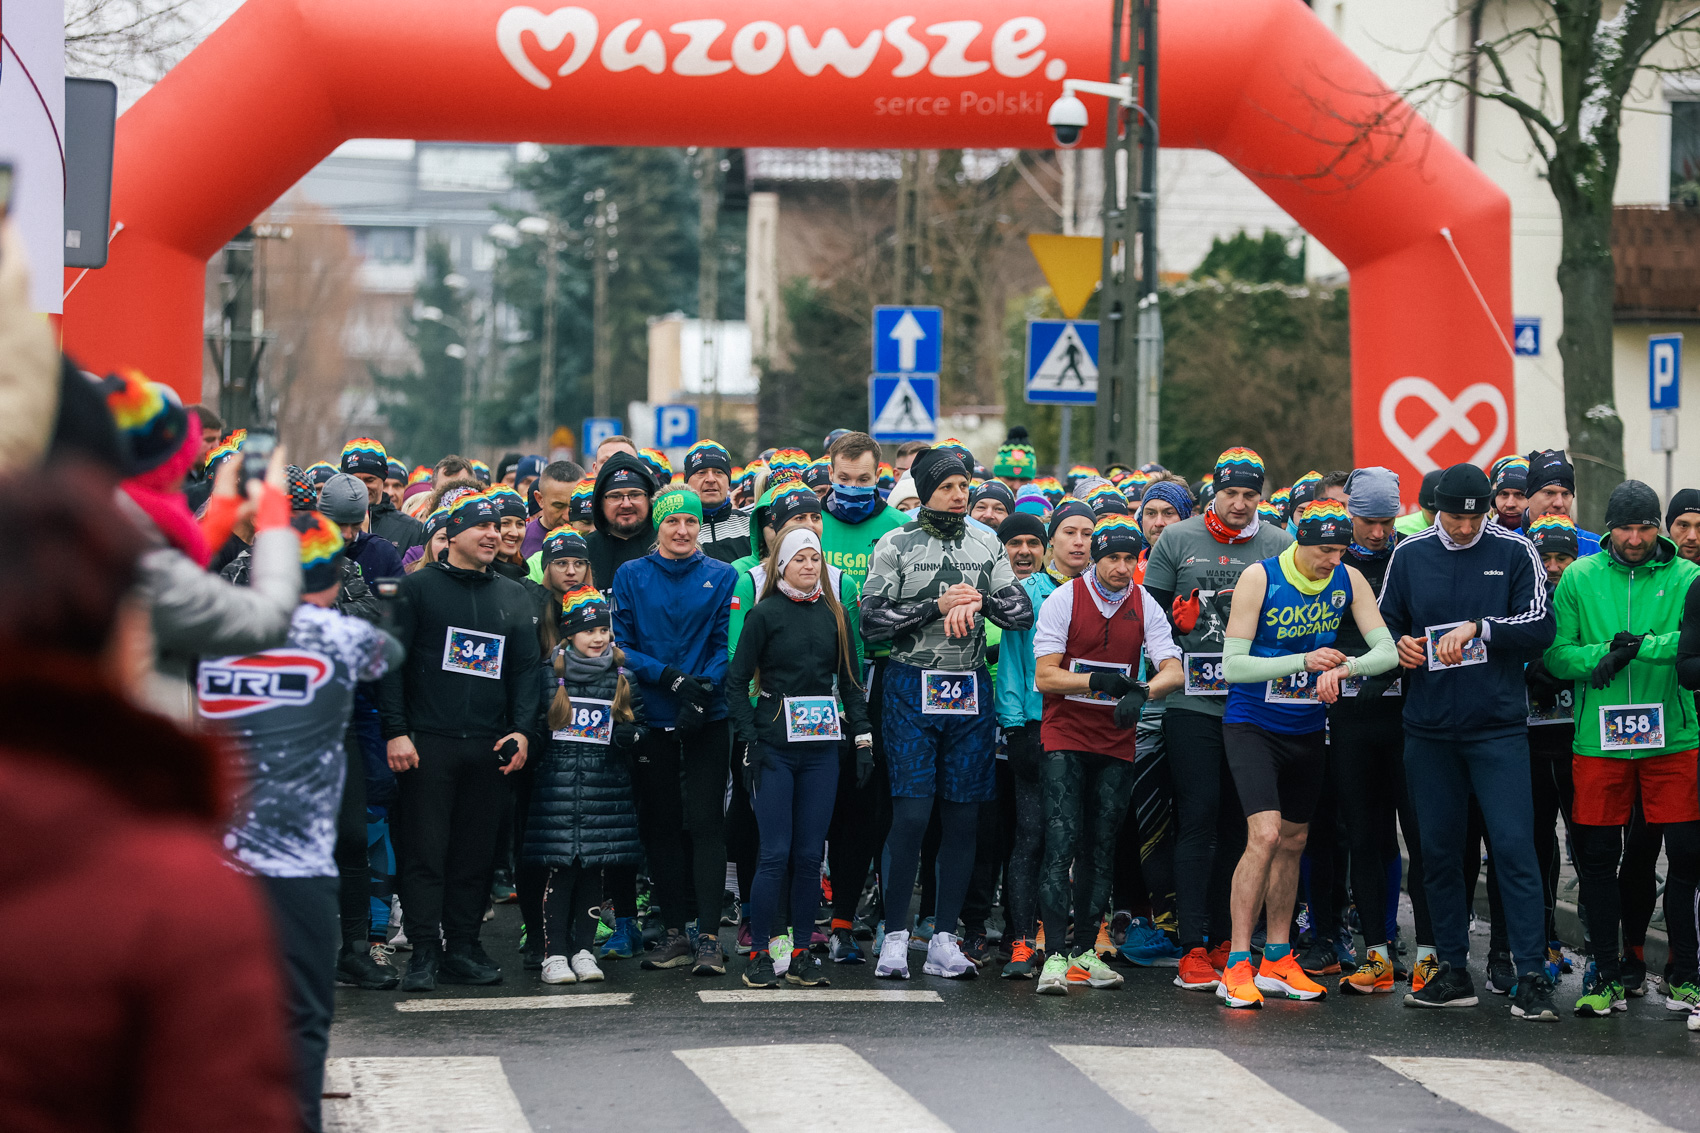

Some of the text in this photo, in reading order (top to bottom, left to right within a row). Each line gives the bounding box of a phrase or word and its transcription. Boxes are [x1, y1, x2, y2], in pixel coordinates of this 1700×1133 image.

[874, 90, 1044, 116] serce Polski
[1654, 343, 1674, 404] P
[590, 421, 616, 453] P
[661, 409, 690, 446] P
[913, 562, 984, 572] RUNMAGEDDON
[1266, 595, 1335, 627] SOKÓŁ
[1277, 613, 1344, 640] BODZANÓ
[462, 639, 487, 660] 34
[204, 670, 304, 698] PRL
[940, 681, 962, 698] 26
[1290, 671, 1309, 688] 13
[570, 707, 603, 727] 189
[795, 706, 834, 725] 253
[1614, 714, 1651, 734] 158
